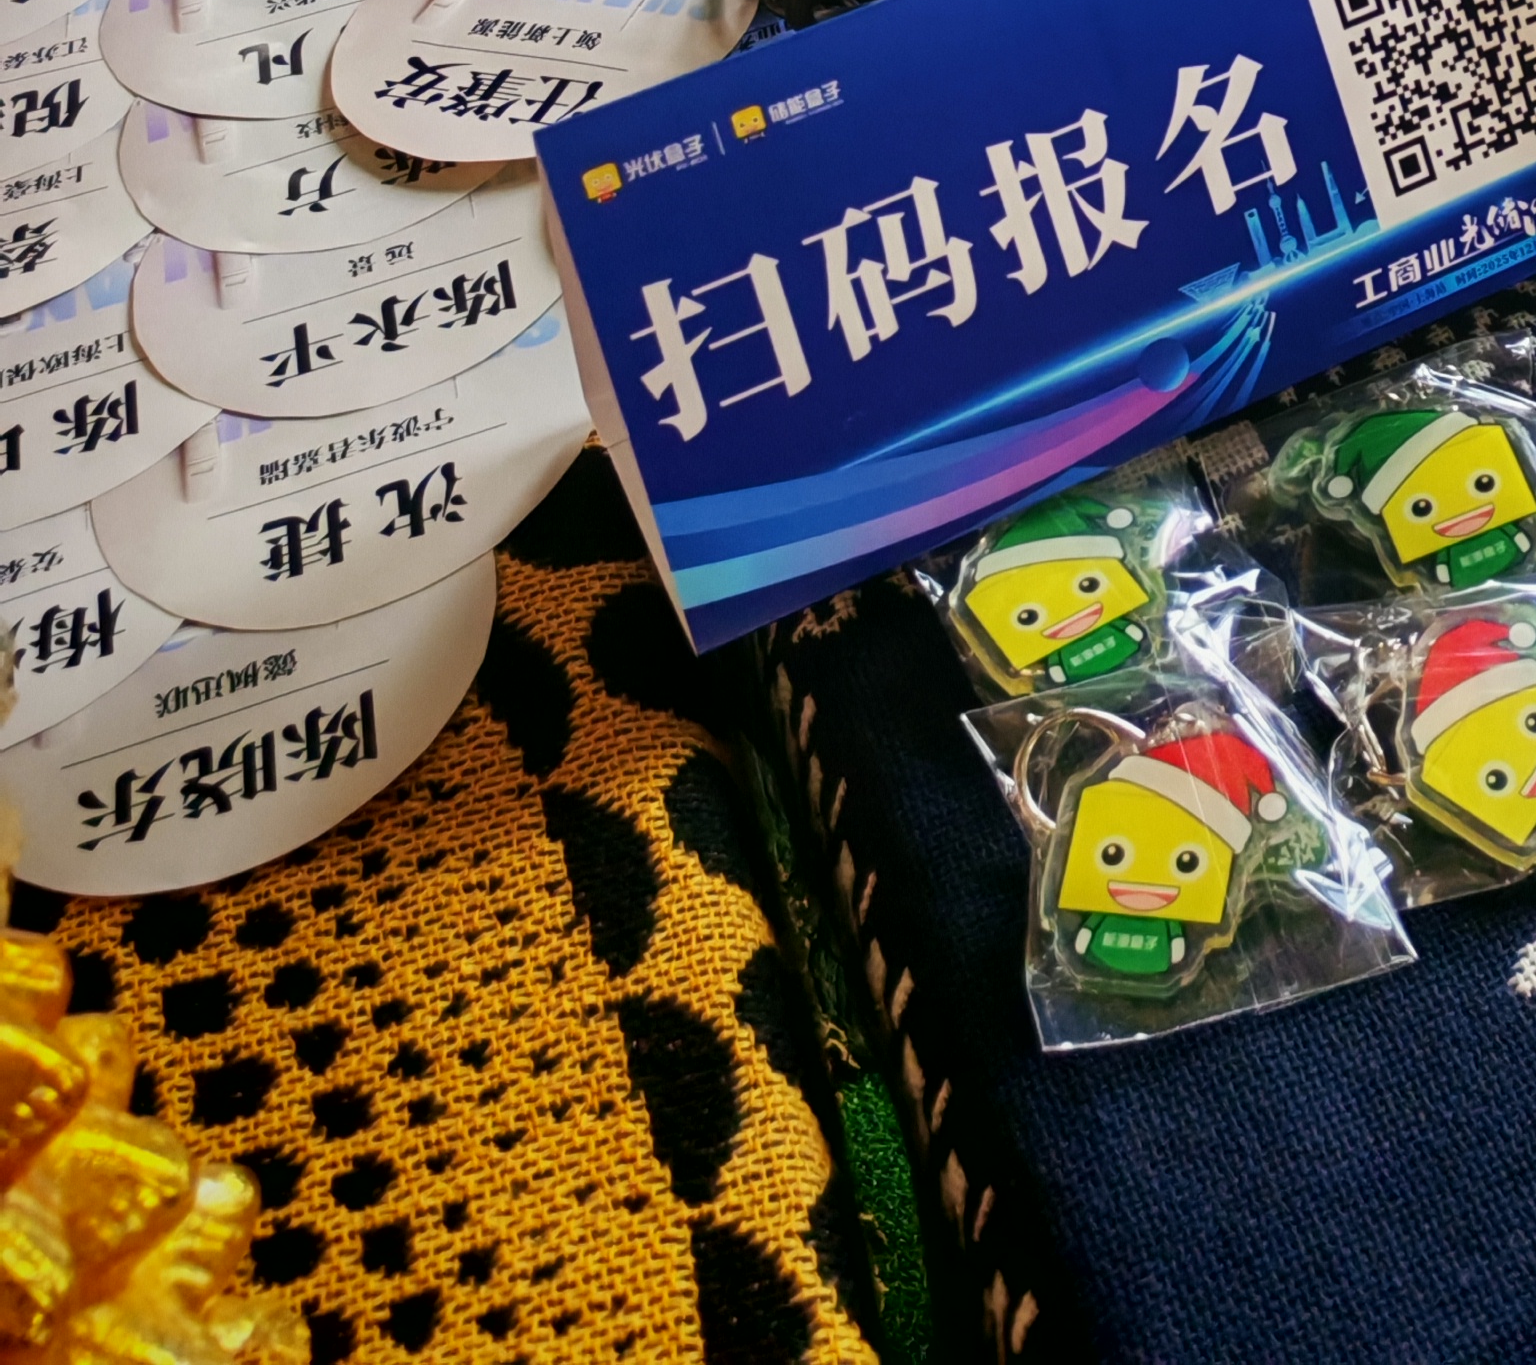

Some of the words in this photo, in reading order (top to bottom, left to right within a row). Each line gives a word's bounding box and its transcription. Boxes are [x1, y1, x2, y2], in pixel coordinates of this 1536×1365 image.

[466, 18, 602, 51] 领上新能源
[0, 79, 90, 138] 倪
[375, 57, 605, 126] 汪肇安
[768, 80, 841, 124] 储能盒子
[624, 135, 705, 182] 光伏盒子
[347, 241, 415, 278] 远景
[629, 54, 1297, 442] 扫码报名
[259, 259, 517, 388] 陈永平
[0, 333, 124, 389] 上海欧保
[258, 408, 454, 486] 宁波东君嘉瑞
[258, 461, 468, 581] 沈捷
[12, 588, 126, 674] 梅
[76, 689, 378, 852] 陈晓东
